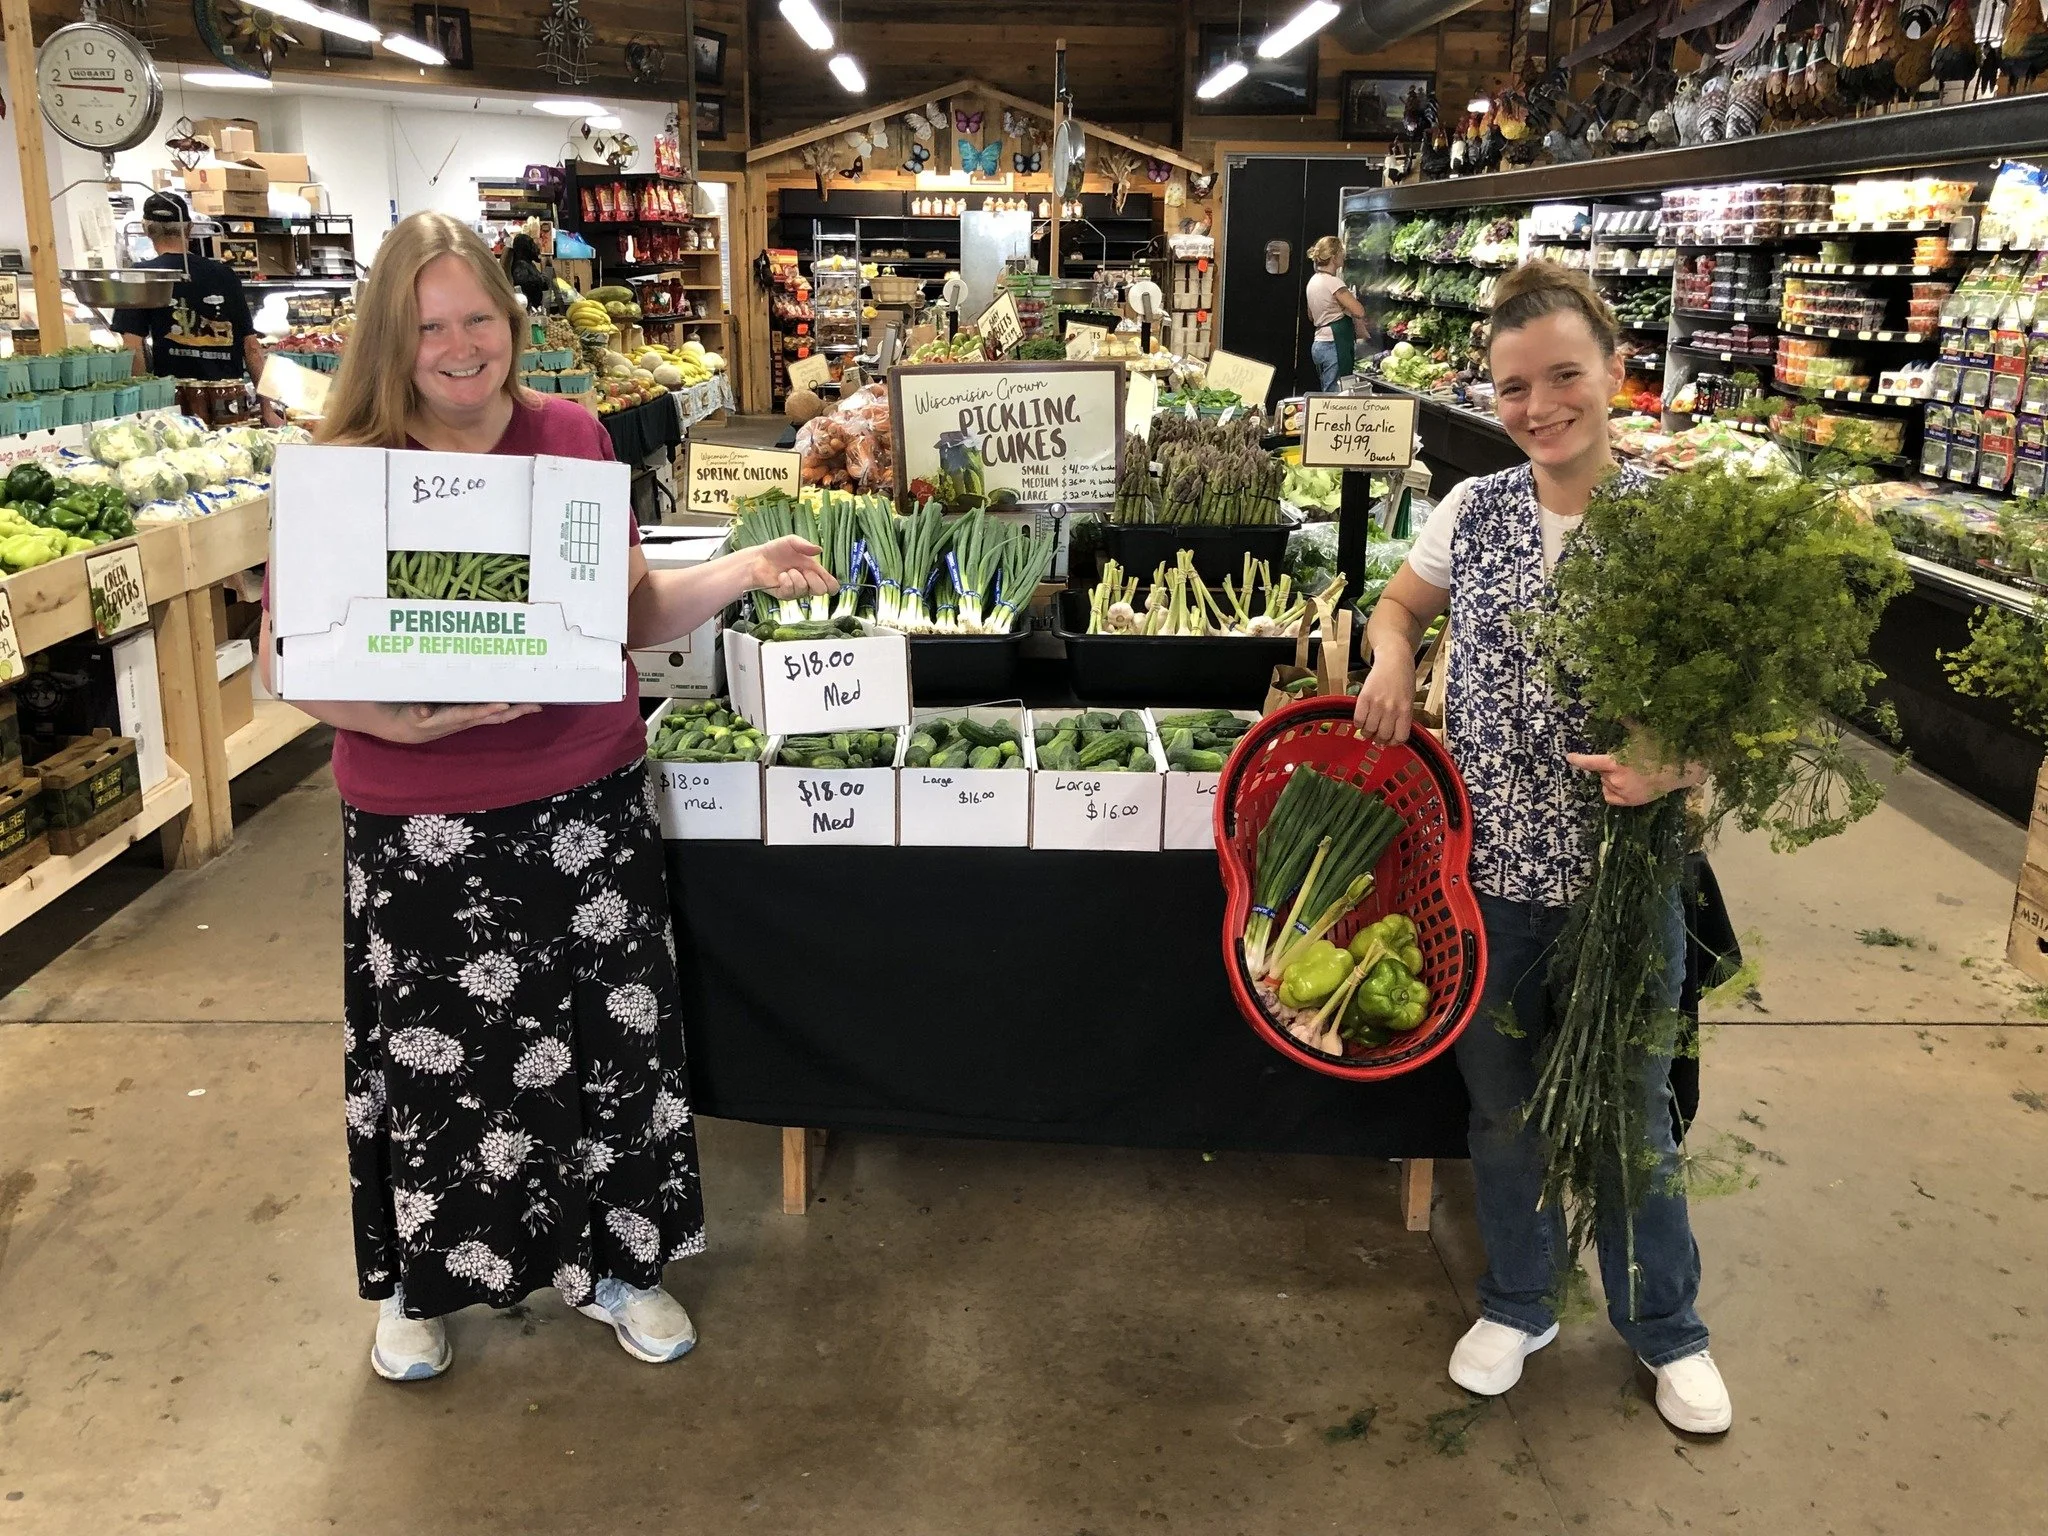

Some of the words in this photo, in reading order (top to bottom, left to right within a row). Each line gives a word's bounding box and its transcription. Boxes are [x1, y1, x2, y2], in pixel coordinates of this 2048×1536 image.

[65, 49, 70, 60] 1
[84, 42, 94, 55] 0
[107, 49, 116, 62] 9
[52, 69, 61, 81] 2
[124, 69, 134, 81] 8
[55, 94, 64, 106] 3
[128, 95, 137, 107] 7
[71, 114, 80, 126] 4
[116, 114, 124, 126] 6
[95, 121, 103, 133] 5
[996, 378, 1048, 401] Grown
[1322, 400, 1357, 410] Wisconsin
[1363, 400, 1390, 411] Grown
[958, 394, 1081, 436] PICKLING
[1314, 413, 1351, 432] Fresh
[1356, 414, 1396, 433] Garlic
[981, 427, 1067, 467] CUKES
[696, 467, 740, 481] SPRING
[743, 467, 789, 481] ONIONS
[1022, 465, 1049, 475] SMALL
[1022, 477, 1059, 488] MEDIUM
[412, 475, 486, 504] $26.00
[1022, 490, 1048, 501] LARGE
[104, 564, 128, 592] GREEN
[390, 610, 526, 634] PERISHABLE
[367, 635, 414, 654] KEEP
[420, 636, 547, 656] REFRIGERATED
[784, 651, 855, 681] $18.00
[824, 679, 861, 711] Med
[659, 772, 710, 792] $18.00
[922, 775, 953, 787] Large
[1055, 777, 1101, 796] Large
[798, 780, 864, 807] $18.00
[958, 791, 995, 804] $16.00
[813, 808, 855, 833] Med
